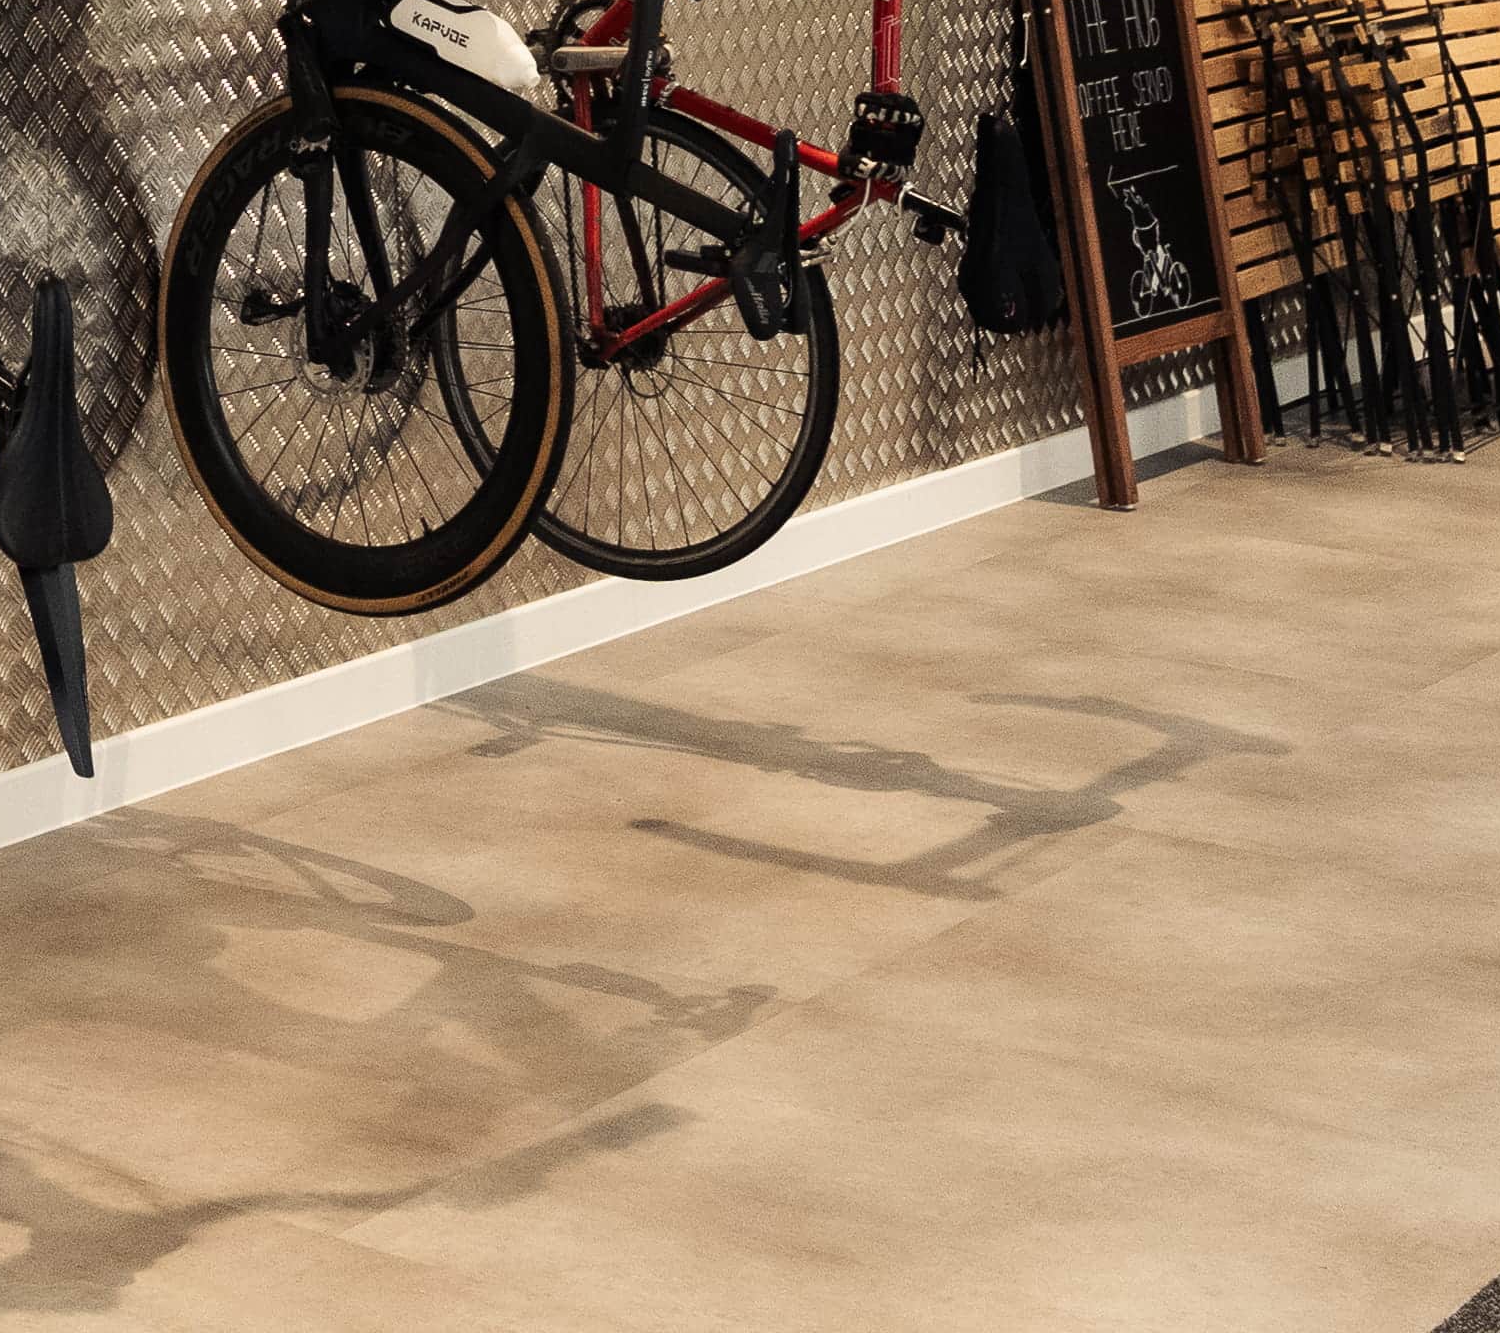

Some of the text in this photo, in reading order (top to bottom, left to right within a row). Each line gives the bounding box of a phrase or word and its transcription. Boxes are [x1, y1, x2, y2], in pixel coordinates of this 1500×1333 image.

[411, 11, 470, 48] KAPVOE
[1078, 66, 1174, 120] OFFEE SERVED
[1110, 110, 1147, 152] HERE
